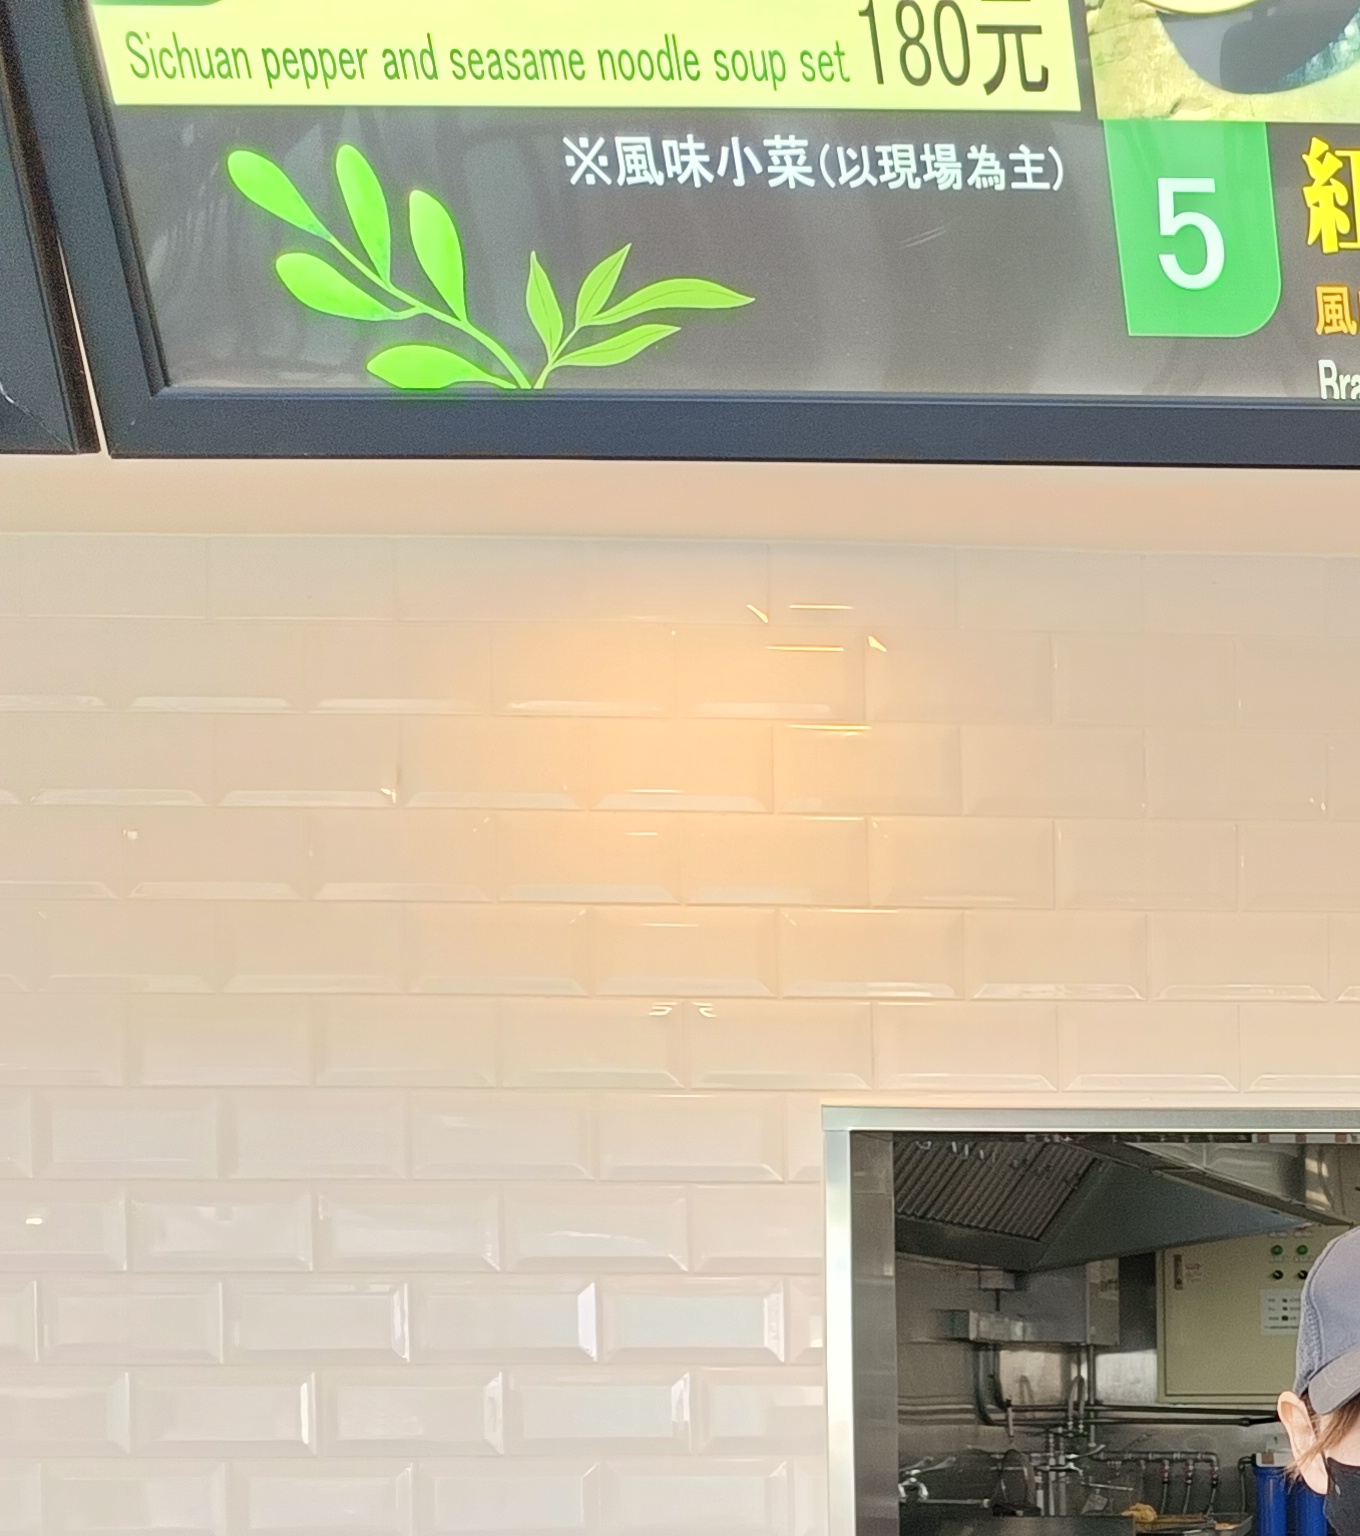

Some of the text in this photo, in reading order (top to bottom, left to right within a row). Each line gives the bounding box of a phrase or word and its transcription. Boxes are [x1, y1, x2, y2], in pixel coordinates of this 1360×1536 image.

[125, 30, 850, 91] Sichuan pepper and seasame noodle soup set
[858, 0, 1050, 96] 180元
[1156, 176, 1227, 291] 5
